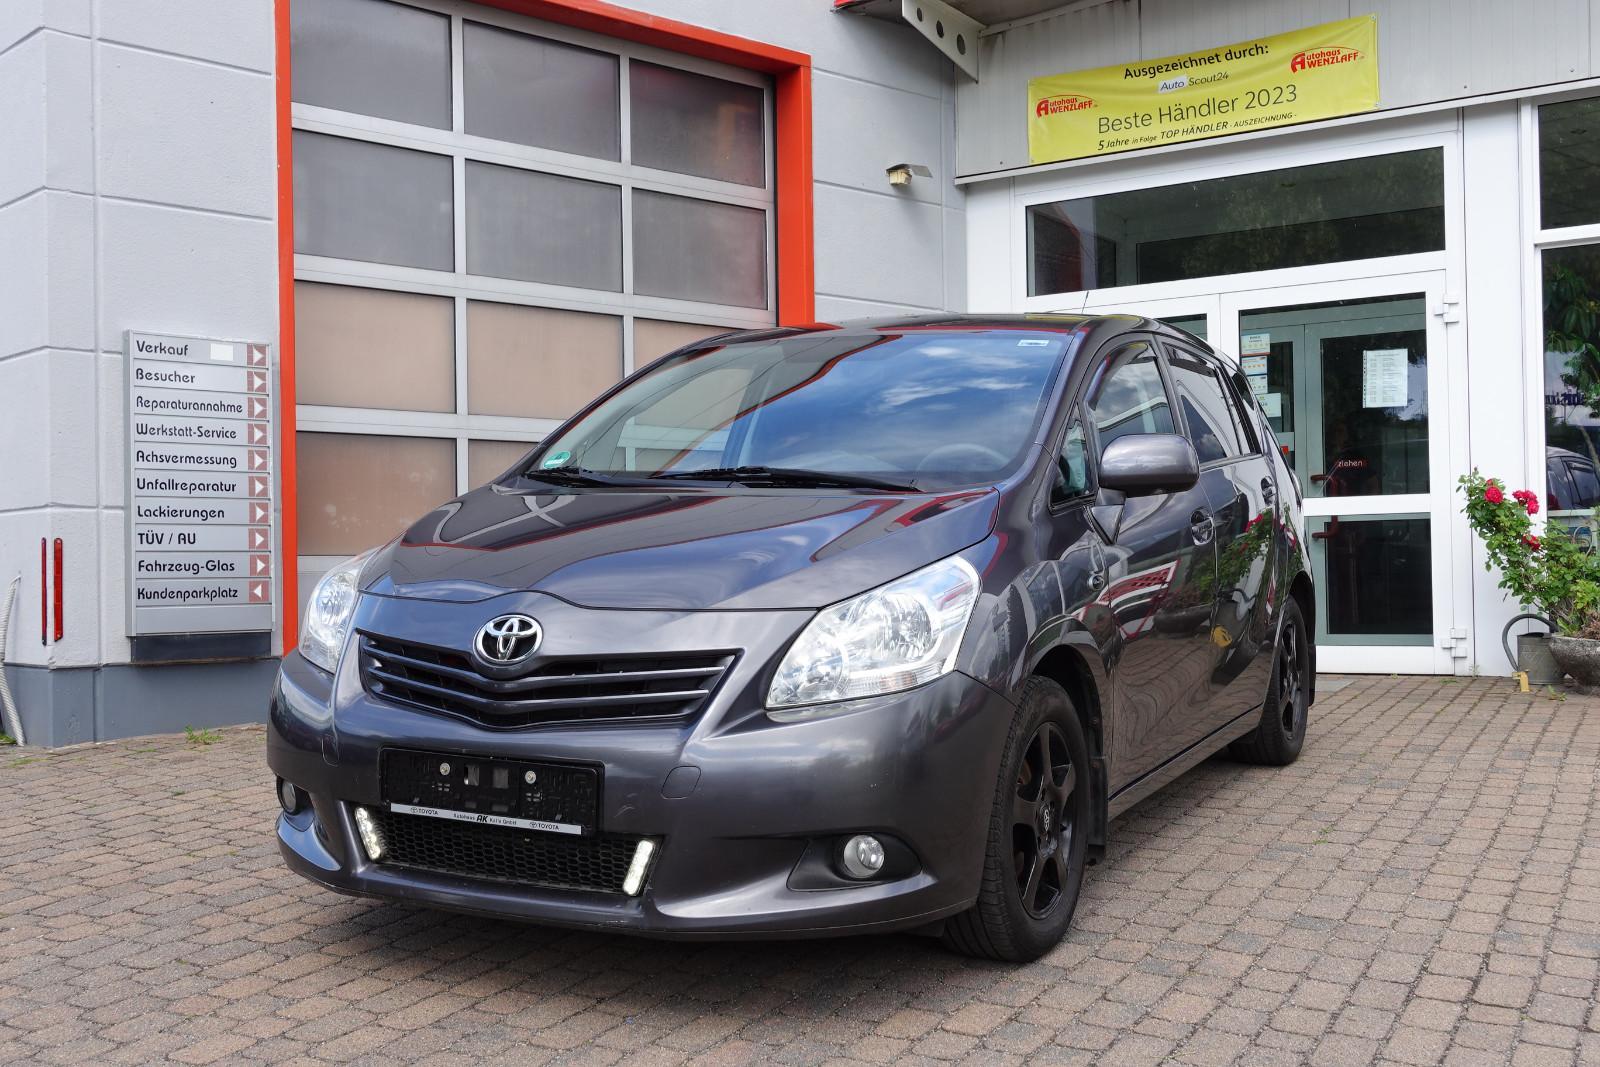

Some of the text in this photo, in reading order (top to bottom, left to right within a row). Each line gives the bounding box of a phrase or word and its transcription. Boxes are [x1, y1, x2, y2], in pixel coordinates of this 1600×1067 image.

[1124, 43, 1269, 80] Ausgezeichnet durch:
[1307, 52, 1359, 69] WENZLAFF
[1159, 71, 1229, 92] Auto Scout24
[1050, 100, 1093, 114] WENZLAFF
[1098, 84, 1297, 134] Beste Händler 2023
[1097, 139, 1105, 151] 5
[1105, 138, 1130, 149] Jahre
[1132, 137, 1138, 145] in
[1139, 135, 1157, 144] Folge
[1160, 129, 1180, 140] TOP
[1181, 121, 1229, 137] HÄNDLER
[1233, 112, 1293, 128] AUSZEICHNUNG
[136, 340, 189, 357] Verkauf
[135, 367, 196, 383] Besucher
[136, 396, 243, 413] Reparaturannahme
[136, 423, 237, 439] Werkstatt-Service
[136, 450, 237, 469] Achsvermessung
[136, 477, 237, 495] Unfallreparatur
[137, 505, 225, 521] Lackierungen
[137, 529, 197, 545] TÜV / AU
[138, 559, 236, 575] Fahrzeug-Glas
[137, 586, 239, 603] Kundenparkplatz
[418, 808, 439, 816] TOYOTA
[476, 814, 489, 823] AK
[537, 822, 560, 831] TOYOTA
